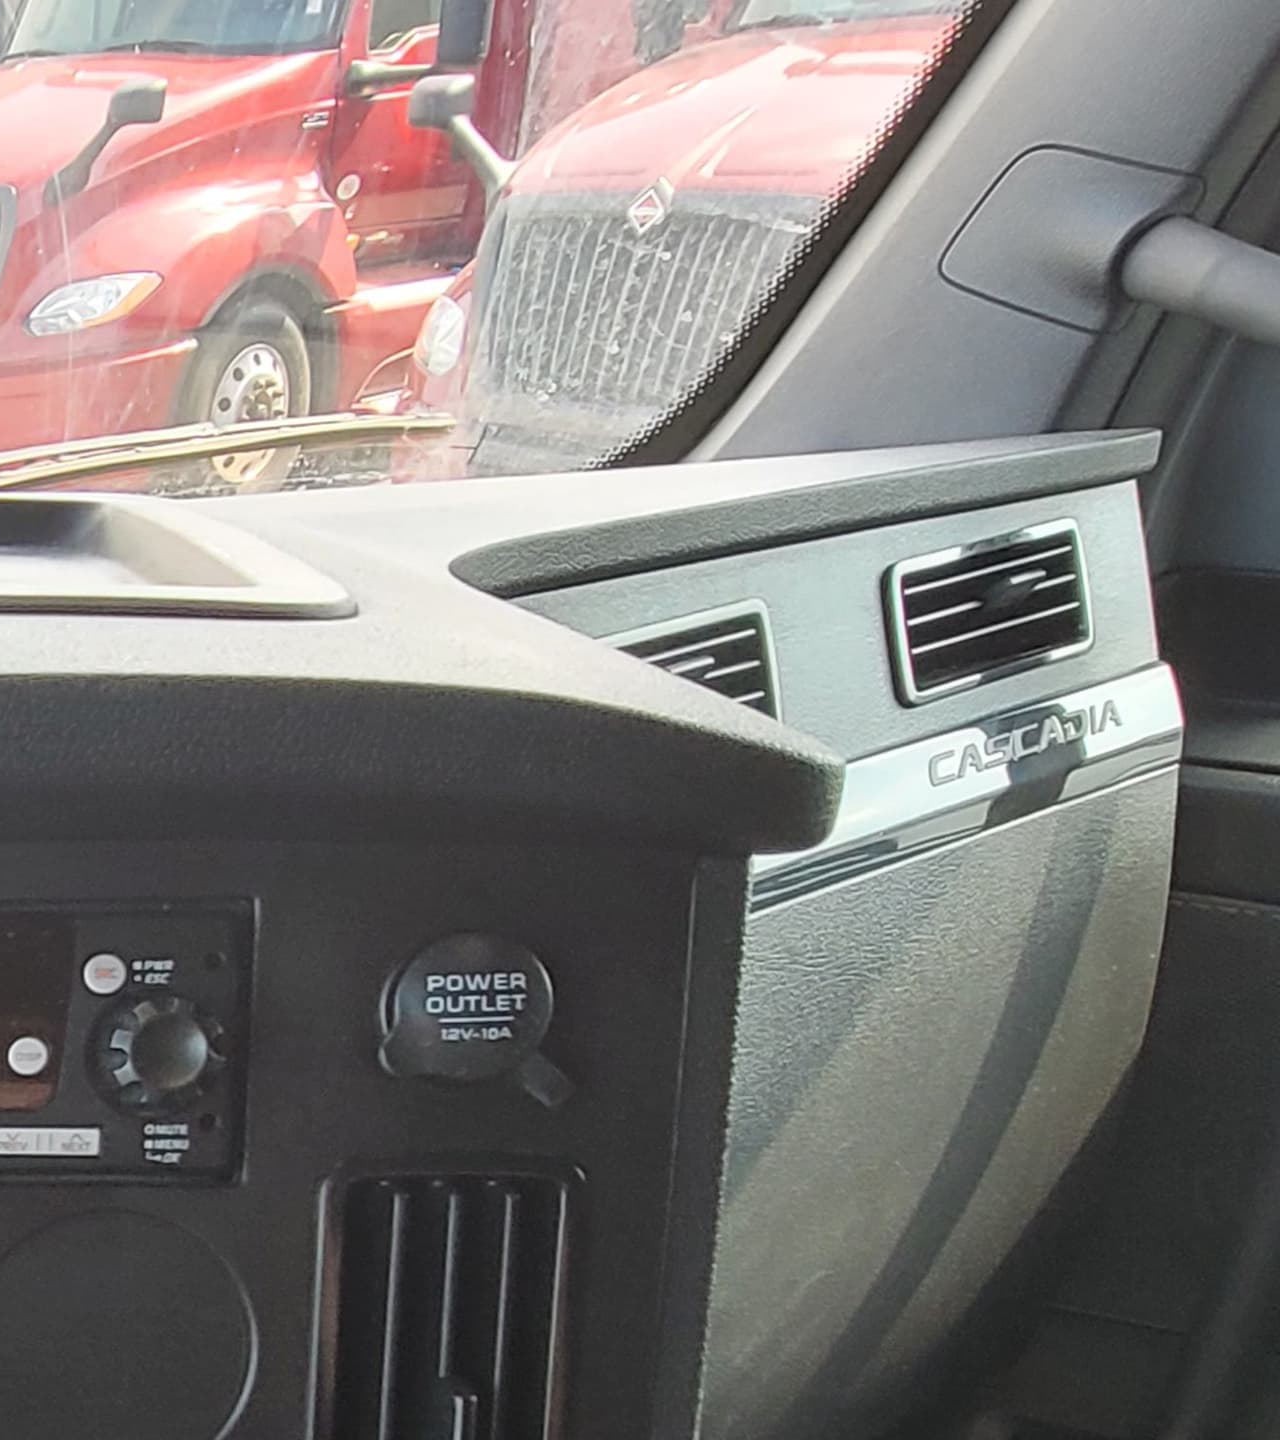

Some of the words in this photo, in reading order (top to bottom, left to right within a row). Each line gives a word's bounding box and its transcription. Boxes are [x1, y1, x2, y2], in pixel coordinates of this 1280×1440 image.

[928, 700, 1122, 787] CASCADIA
[426, 972, 527, 992] POWER
[425, 994, 527, 1013] OUTLET
[440, 1026, 512, 1041] 12V-10A
